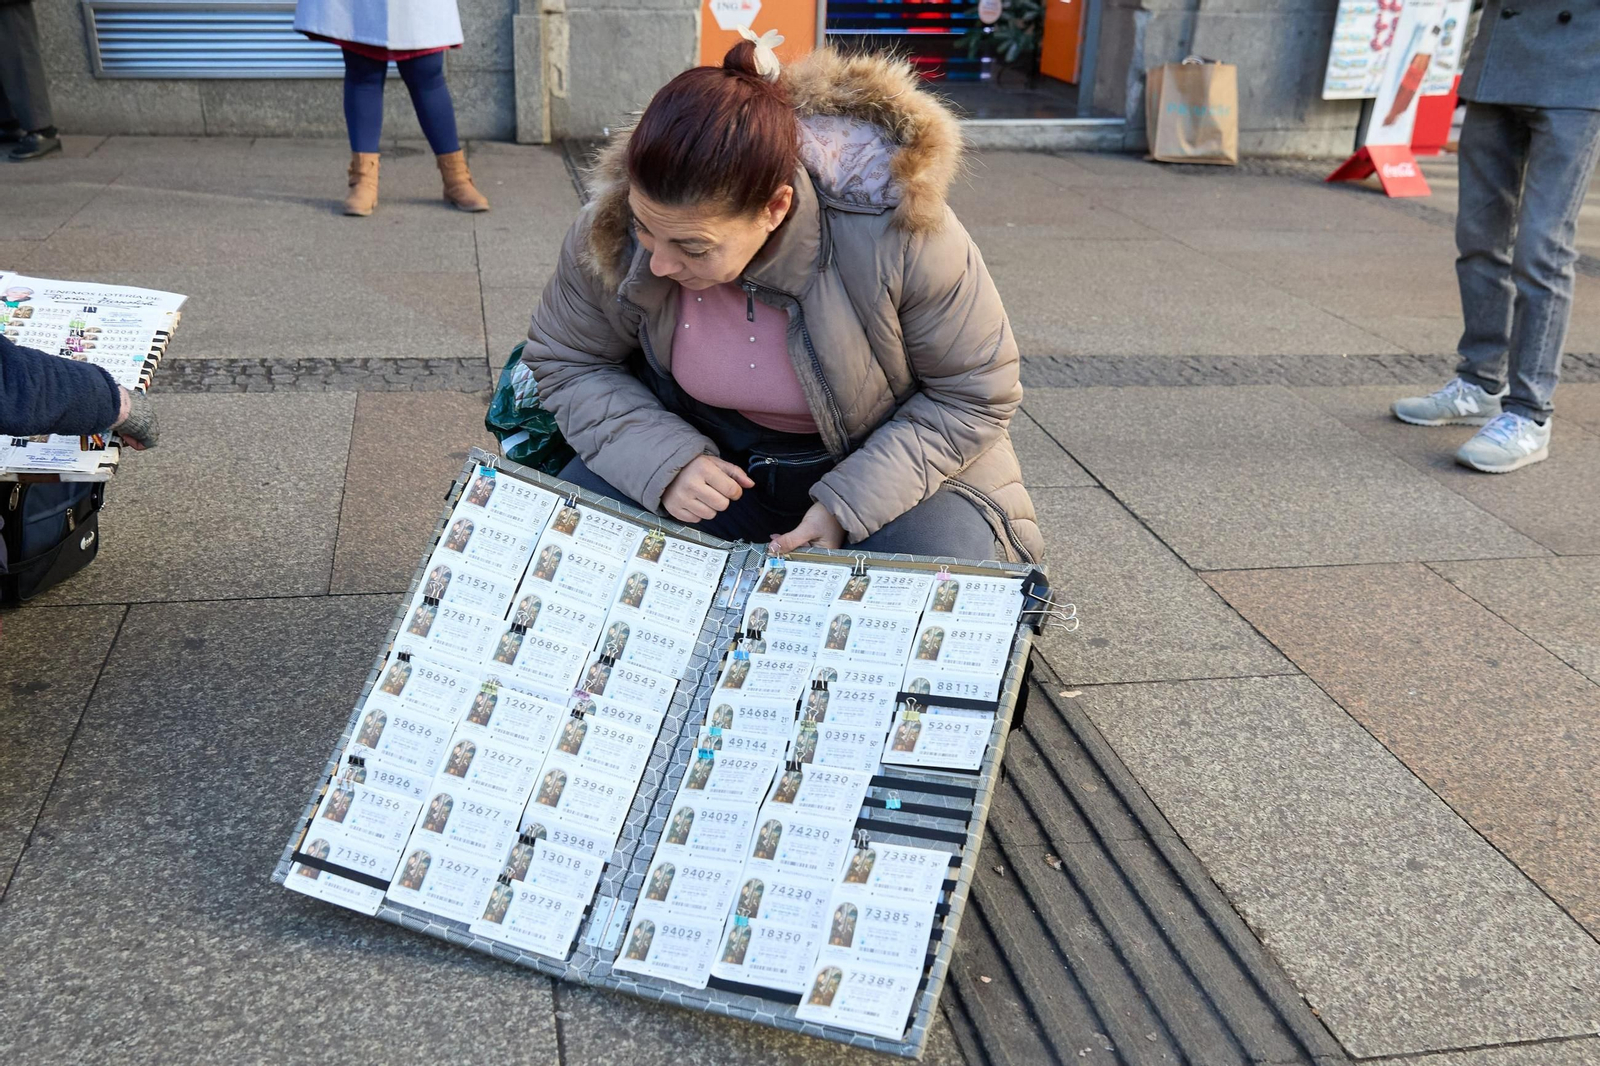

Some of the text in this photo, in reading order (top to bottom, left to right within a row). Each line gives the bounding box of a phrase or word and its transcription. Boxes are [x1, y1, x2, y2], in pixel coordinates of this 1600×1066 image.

[717, 2, 738, 10] ING
[1454, 396, 1479, 416] N
[1518, 433, 1539, 455] N
[501, 483, 538, 500] 41521
[586, 514, 623, 531] 62712
[479, 527, 517, 545] 41521
[671, 542, 709, 558] 20543
[568, 552, 606, 573] 62712
[792, 567, 828, 576] 95724
[458, 574, 495, 592] 41521
[876, 576, 914, 584] 73385
[966, 583, 1006, 591] 88113
[655, 580, 693, 599] 20543
[442, 608, 481, 625] 27811
[547, 603, 586, 622] 62712
[774, 611, 811, 623] 95724
[858, 618, 897, 628] 73385
[636, 630, 675, 648] 20543
[951, 630, 992, 640] 88113
[530, 636, 568, 655] 06862
[771, 641, 808, 653] 48634
[756, 660, 794, 669] 54684
[418, 668, 456, 687] 58636
[617, 669, 657, 688] 20543
[844, 671, 884, 683] 73385
[836, 690, 875, 701] 72625
[937, 682, 979, 694] 88113
[504, 697, 544, 714] 12677
[739, 707, 776, 718] 54684
[602, 705, 642, 723] 49678
[393, 718, 432, 737] 58636
[594, 726, 634, 744] 53948
[928, 722, 969, 732] 52691
[729, 738, 767, 750] 49144
[825, 730, 866, 742] 03915
[483, 749, 522, 766] 12677
[720, 759, 758, 769] 94029
[373, 770, 411, 788] 18926
[573, 777, 614, 795] 53948
[808, 772, 849, 784] 74230
[361, 791, 400, 810] 71356
[461, 801, 501, 819] 12677
[701, 811, 738, 822] 94029
[553, 831, 594, 849] 53948
[789, 825, 830, 839] 74230
[337, 847, 376, 867] 71356
[541, 850, 581, 869] 13018
[882, 850, 926, 863] 73385
[438, 858, 479, 876] 12677
[682, 868, 721, 880] 94029
[771, 884, 812, 899] 74230
[520, 892, 562, 910] 99738
[865, 907, 910, 922] 73385
[662, 926, 702, 940] 94029
[759, 929, 801, 942] 18350
[850, 972, 895, 987] 73385
